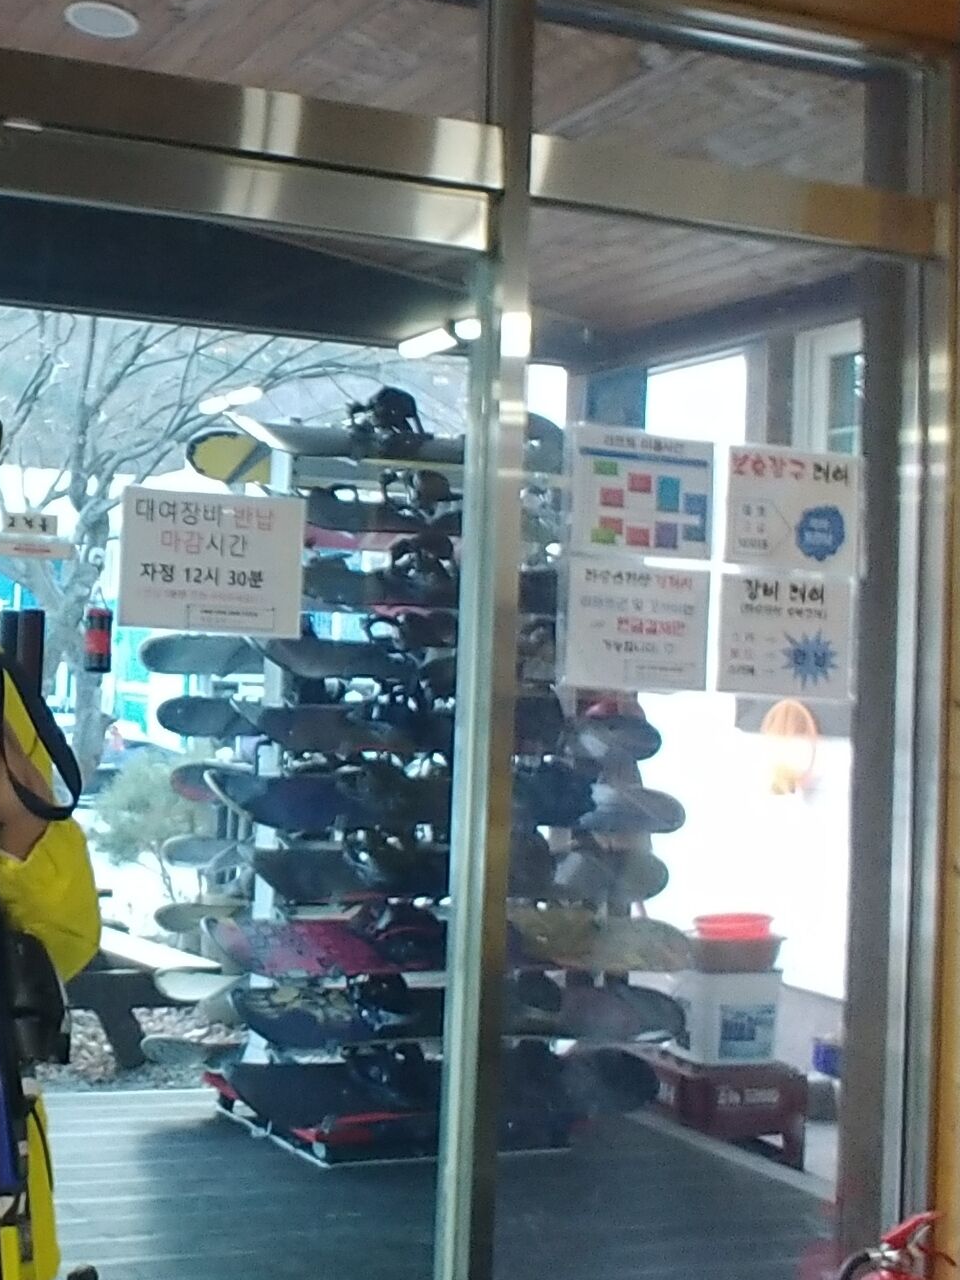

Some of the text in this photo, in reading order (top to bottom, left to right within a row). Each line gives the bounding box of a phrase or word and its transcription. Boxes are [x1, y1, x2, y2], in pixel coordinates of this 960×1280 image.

[135, 498, 276, 531] 대여장비 반납
[160, 529, 248, 558] 마감시간
[140, 562, 264, 589] 자정 12시 30분
